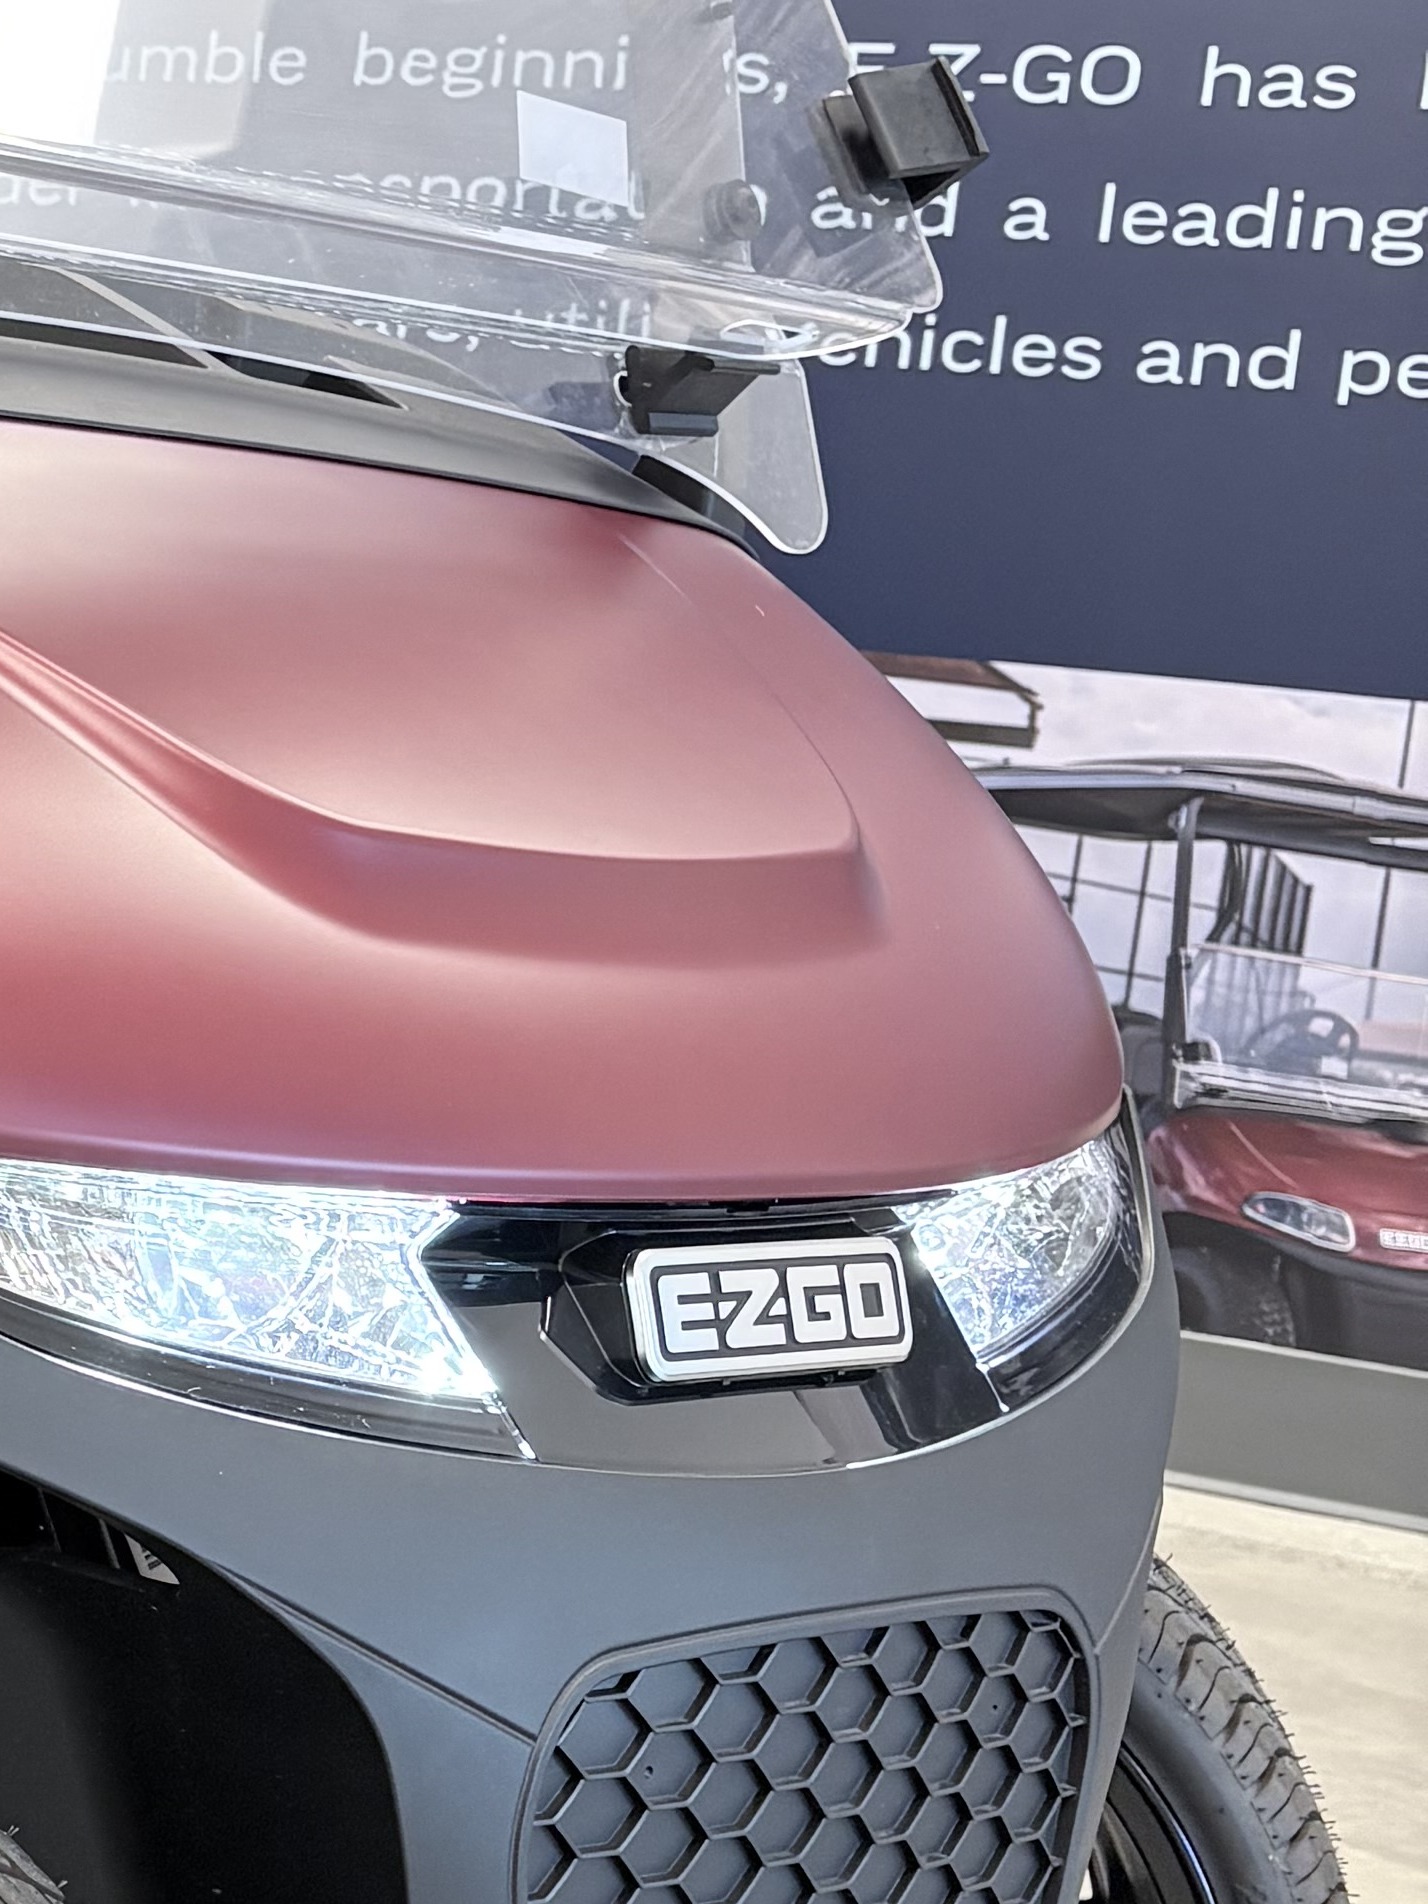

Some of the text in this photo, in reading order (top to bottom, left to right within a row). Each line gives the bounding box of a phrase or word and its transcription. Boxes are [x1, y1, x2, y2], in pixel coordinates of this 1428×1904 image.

[101, 30, 308, 87] umble
[1200, 45, 1359, 112] has
[1003, 193, 1052, 243] a
[1098, 182, 1428, 266] leading
[1135, 328, 1303, 393] and
